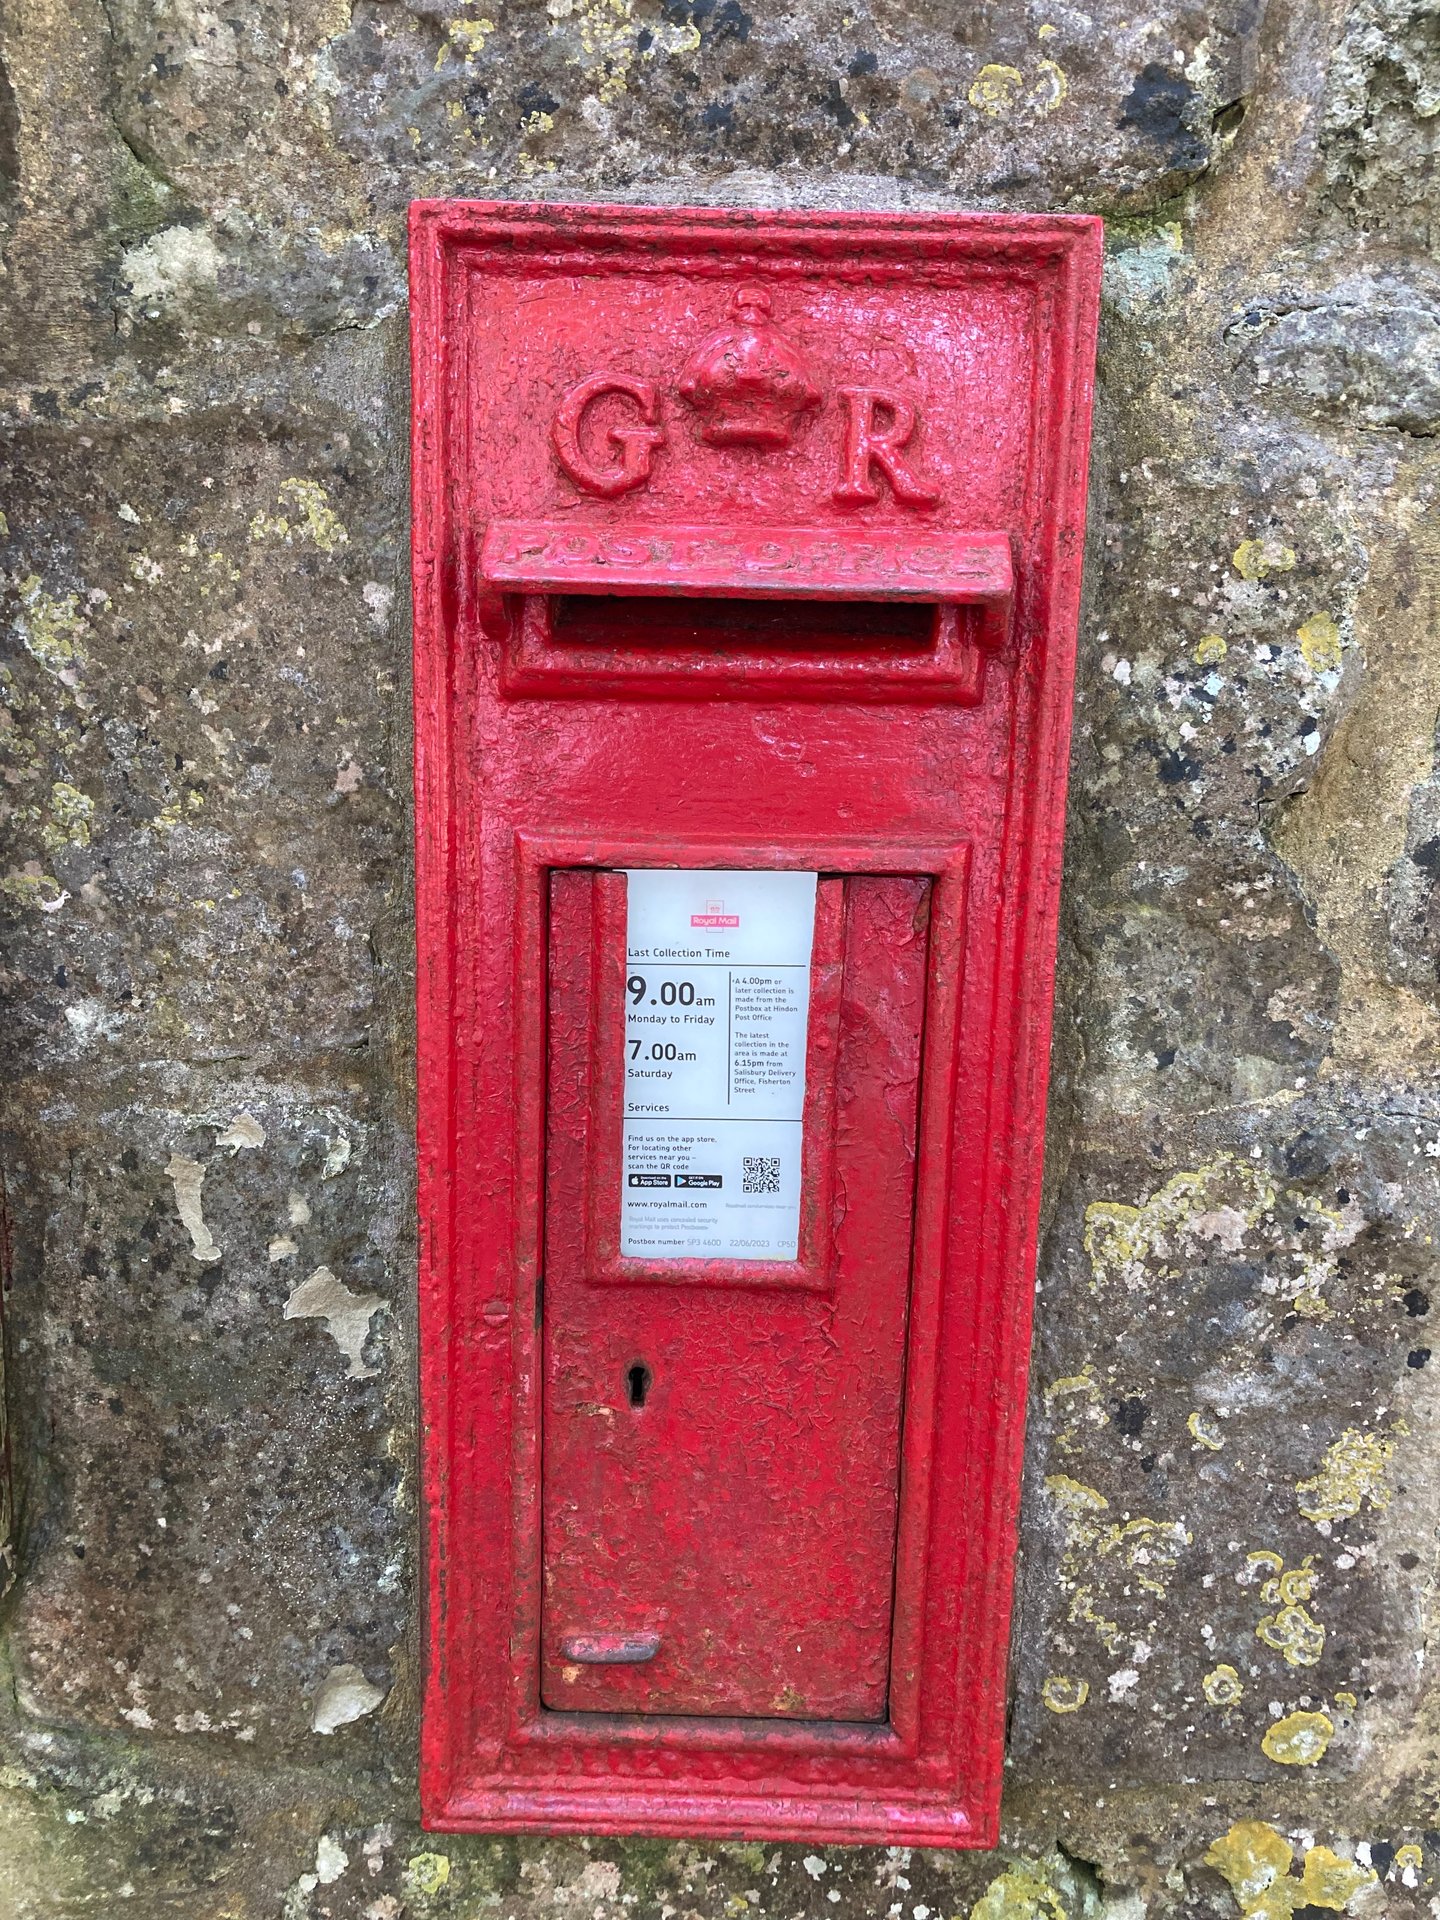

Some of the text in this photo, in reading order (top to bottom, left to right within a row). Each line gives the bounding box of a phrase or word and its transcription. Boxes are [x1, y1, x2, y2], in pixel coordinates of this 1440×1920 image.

[551, 371, 941, 506] G R
[693, 917, 737, 926] Royal Mail
[628, 948, 730, 958] Last Collection Time
[742, 978, 772, 986] 4.00pm
[627, 975, 716, 1006] 9.00am
[628, 1014, 715, 1026] Monday to Friday
[628, 1040, 697, 1061] 7.00am
[734, 1059, 764, 1068] 6.15pm
[628, 1069, 673, 1080] Saturday
[734, 1069, 766, 1077] Salisbury
[628, 1103, 670, 1112] Services
[628, 1200, 708, 1210] www.royalmail.com
[730, 1240, 770, 1248] 22/06/2023
